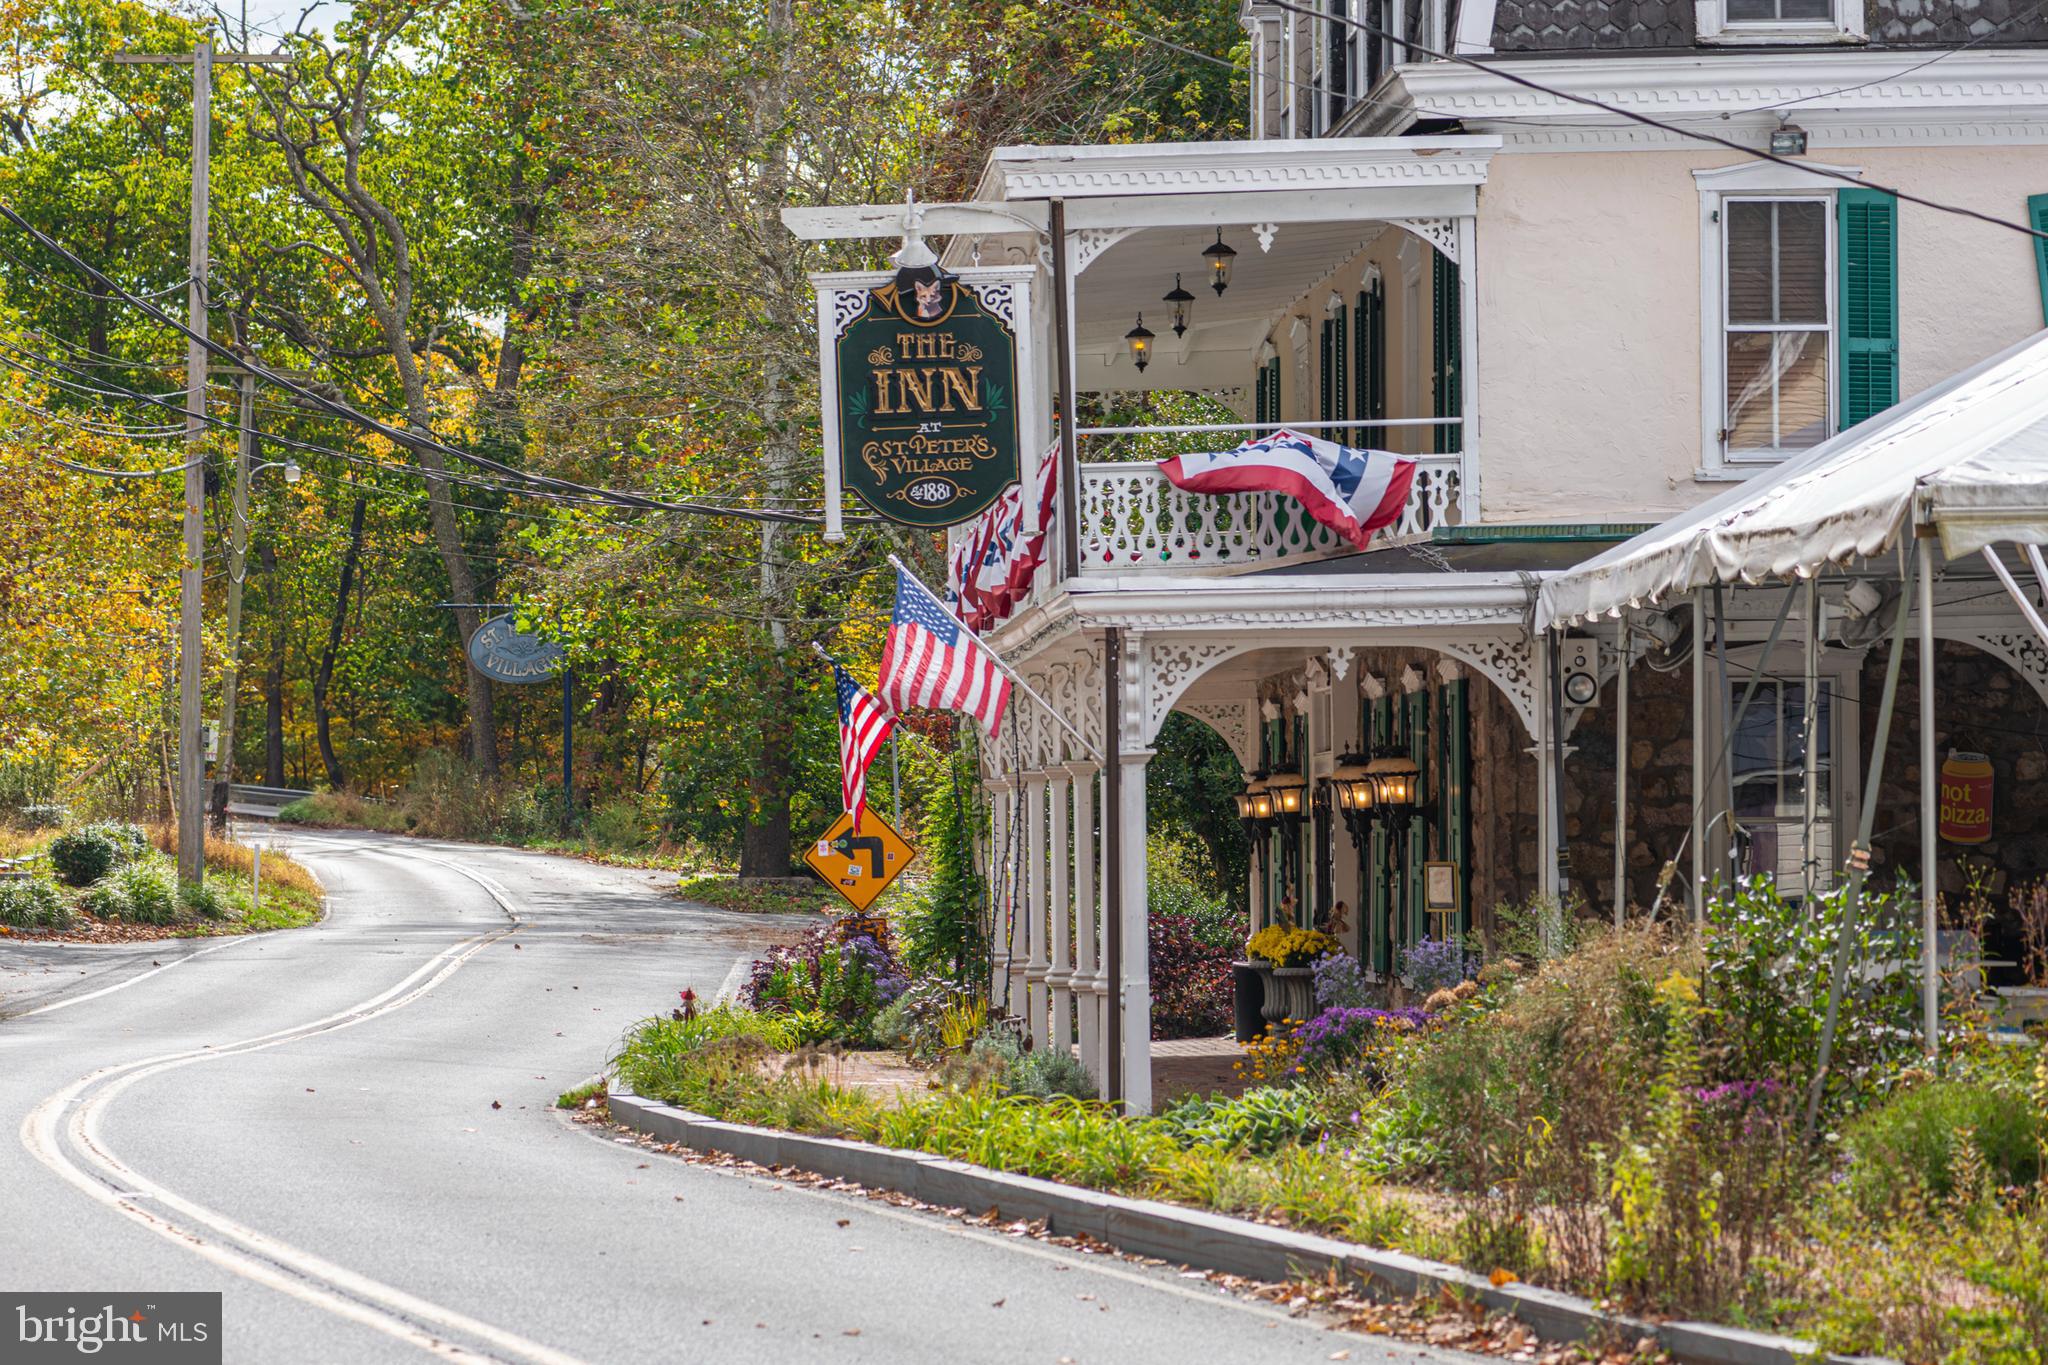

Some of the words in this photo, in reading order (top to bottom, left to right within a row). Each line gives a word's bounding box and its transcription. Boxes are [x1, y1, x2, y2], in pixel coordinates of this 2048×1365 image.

[896, 331, 957, 359] THE
[871, 366, 984, 415] INN
[916, 421, 943, 434] AT
[878, 439, 909, 458] ST.
[909, 434, 997, 460] PETER'S
[890, 456, 974, 475] VILLAGE
[922, 482, 951, 502] 1881
[480, 626, 504, 650] ST.
[1941, 783, 1973, 803] not
[1940, 802, 1990, 825] pizza.
